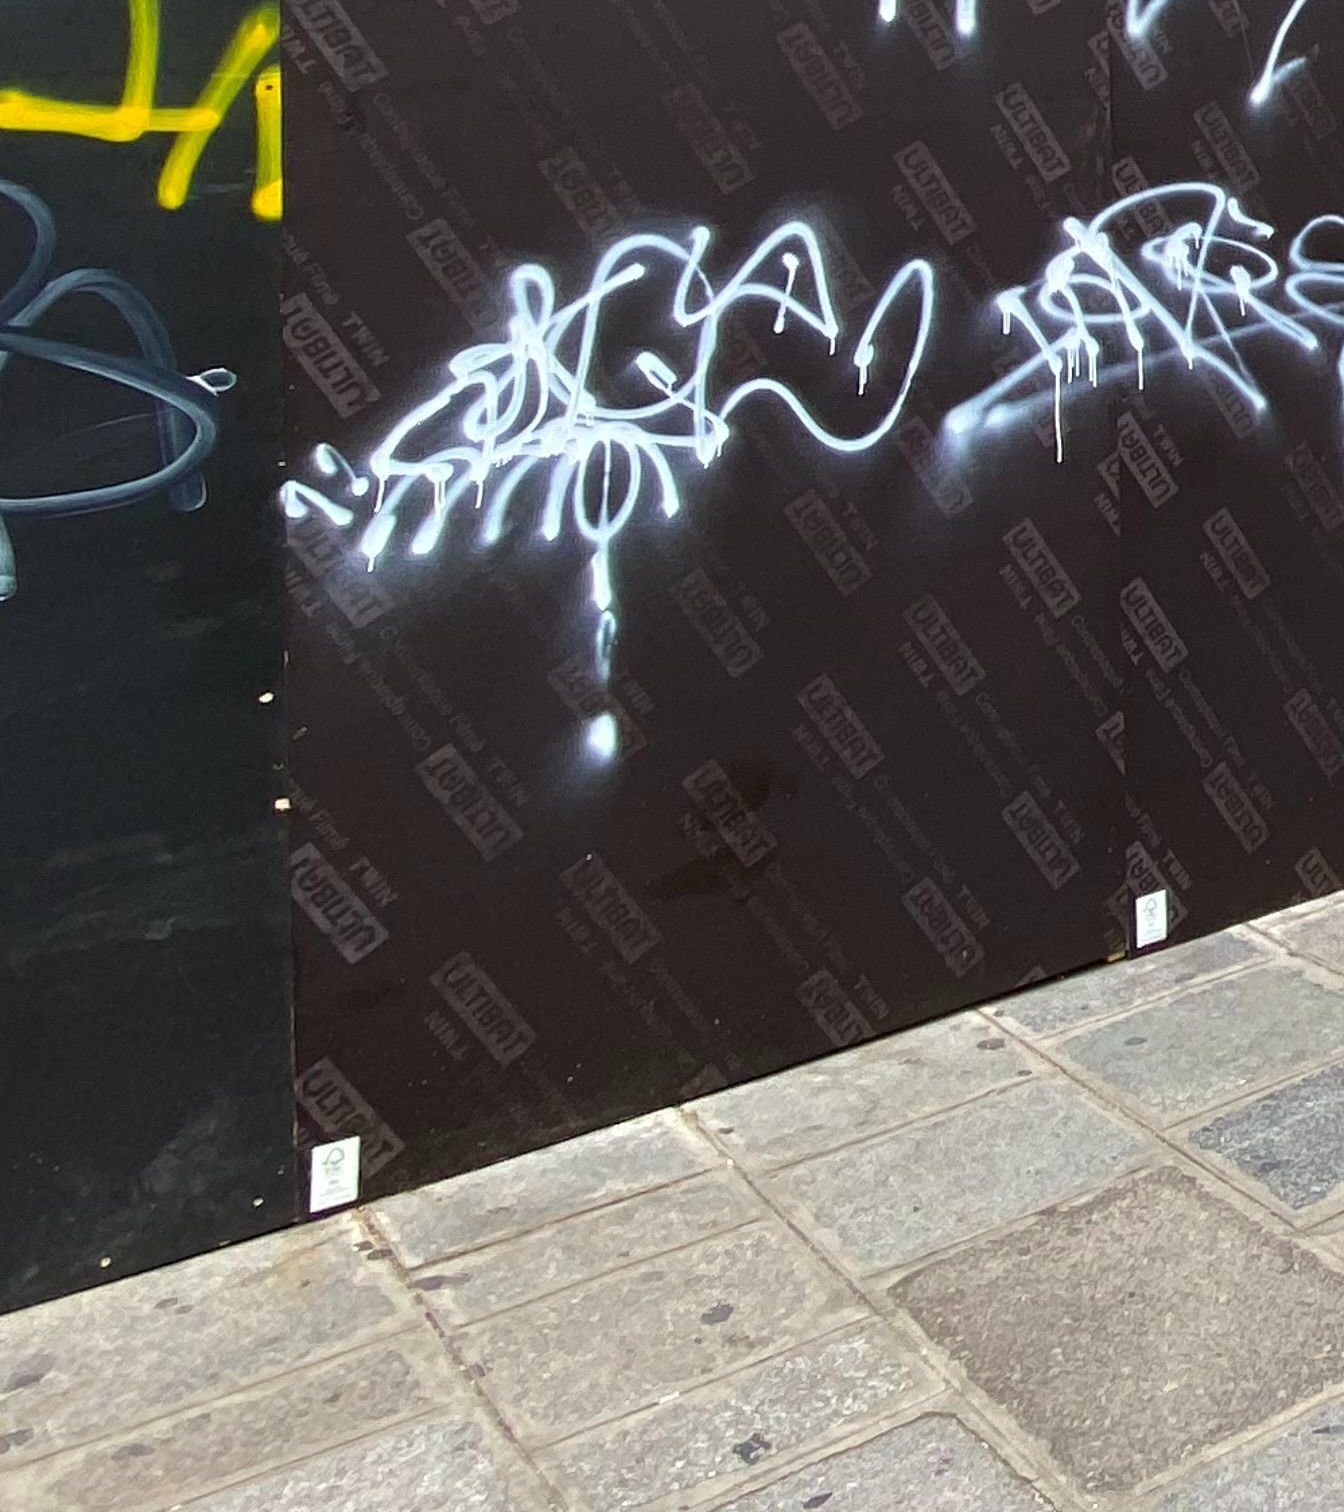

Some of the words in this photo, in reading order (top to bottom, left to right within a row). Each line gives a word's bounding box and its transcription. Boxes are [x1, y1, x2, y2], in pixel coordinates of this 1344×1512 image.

[999, 86, 1068, 178] ULTIBAT
[285, 296, 378, 415] ULTIBAT
[342, 311, 390, 367] TWIN
[1006, 522, 1077, 614] ULTIBAT
[1206, 510, 1267, 595] ULTIBAT
[906, 597, 982, 692] ULTIBAT
[1124, 581, 1185, 669] ULTIBAT
[418, 747, 520, 858] ULTIBAT
[350, 855, 398, 907] TWIN
